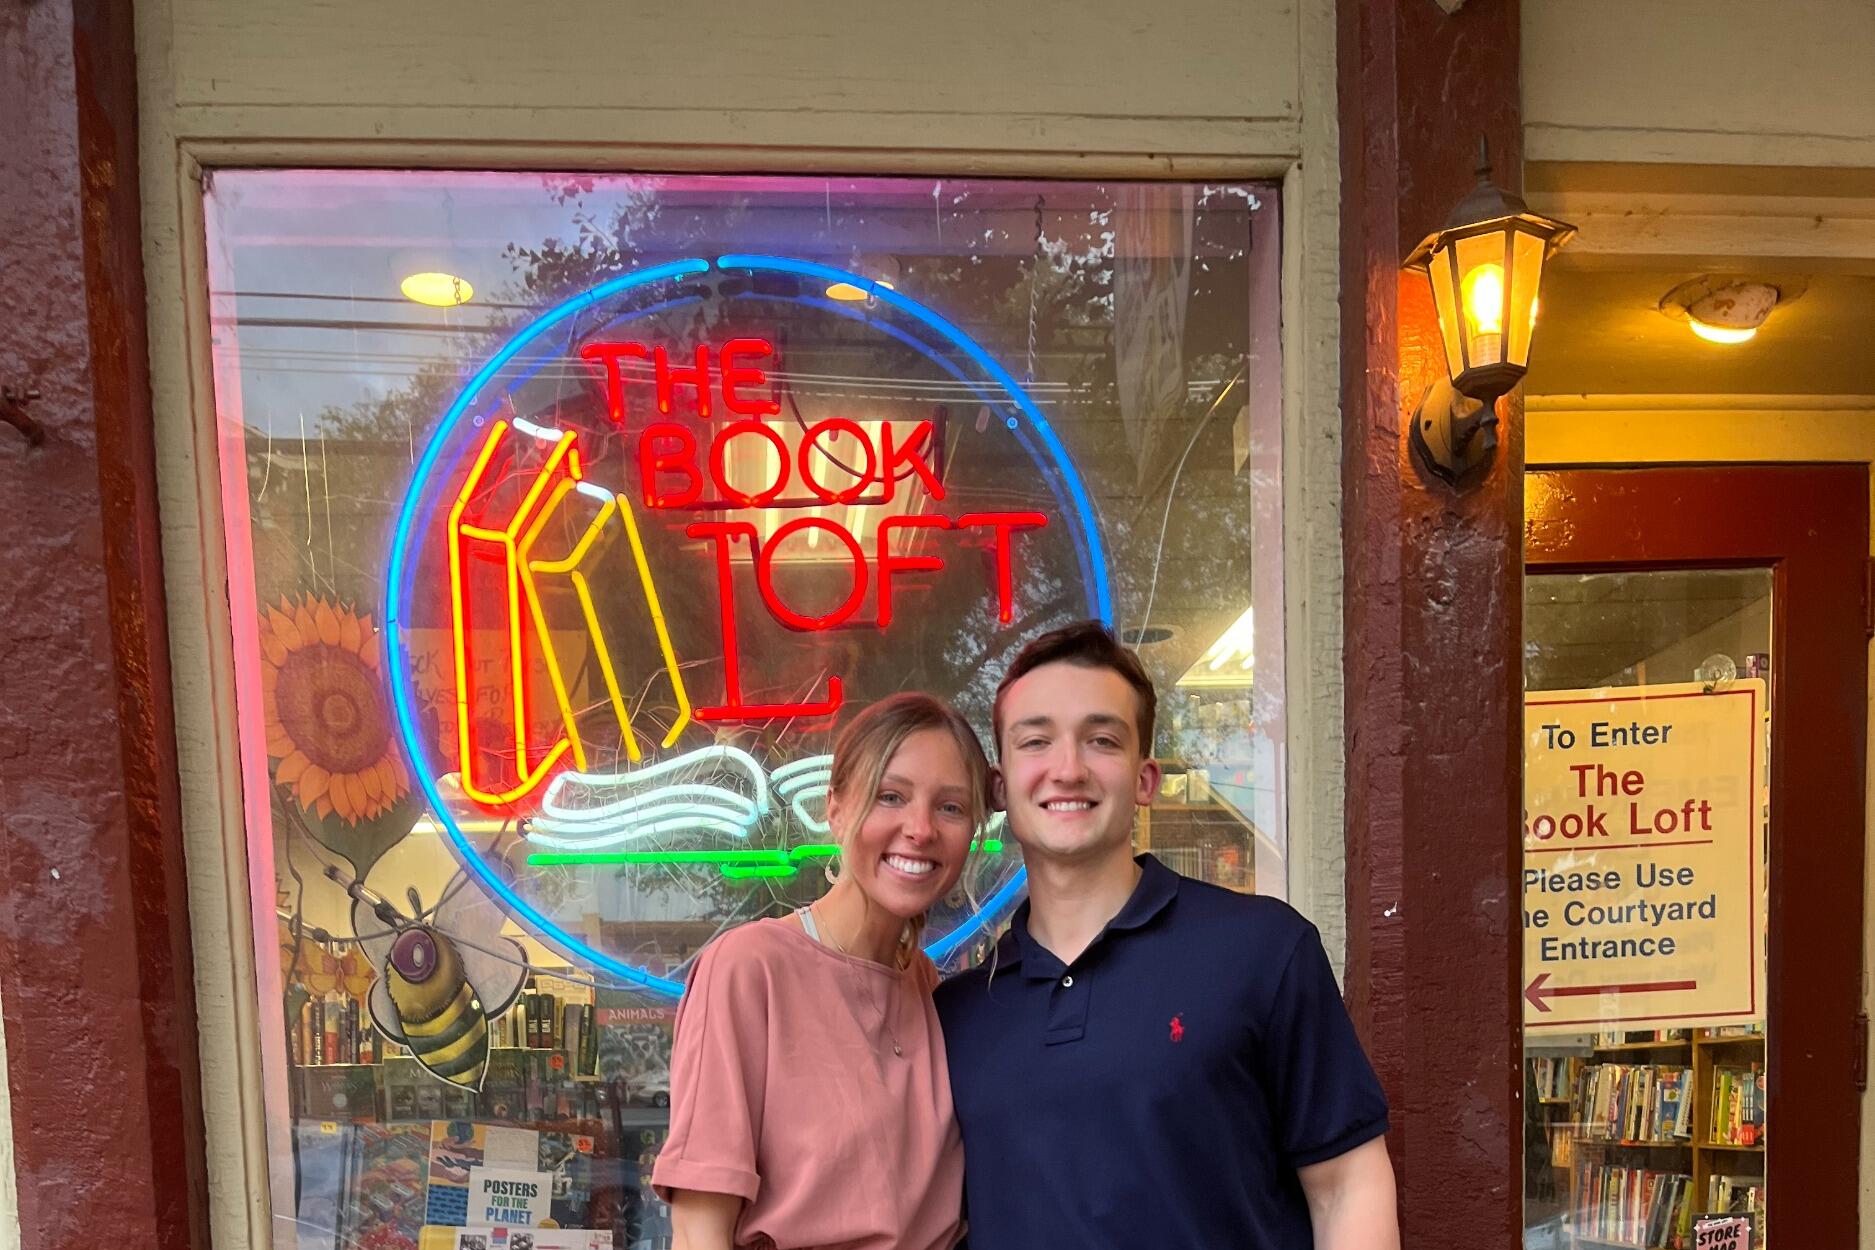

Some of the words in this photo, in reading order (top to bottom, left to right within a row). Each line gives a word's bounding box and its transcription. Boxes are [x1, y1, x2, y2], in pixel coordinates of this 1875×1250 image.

[581, 338, 781, 423] THE
[640, 418, 944, 508] BOOK
[687, 513, 1047, 720] LOFT
[1542, 724, 1576, 750] To
[1591, 722, 1673, 748] Enter
[1570, 764, 1645, 798] The
[1630, 799, 1713, 835] Loft
[1525, 868, 1621, 893] Please
[1636, 863, 1695, 888] Use
[1564, 894, 1717, 927] Courtyard
[1541, 936, 1677, 961] Entrance
[608, 1008, 665, 1020] ANIMALS
[484, 1179, 538, 1198] POSTERS
[491, 1196, 510, 1207] FOR
[511, 1198, 528, 1209] THE
[486, 1207, 533, 1225] PLANET
[1698, 1224, 1741, 1247] STORE
